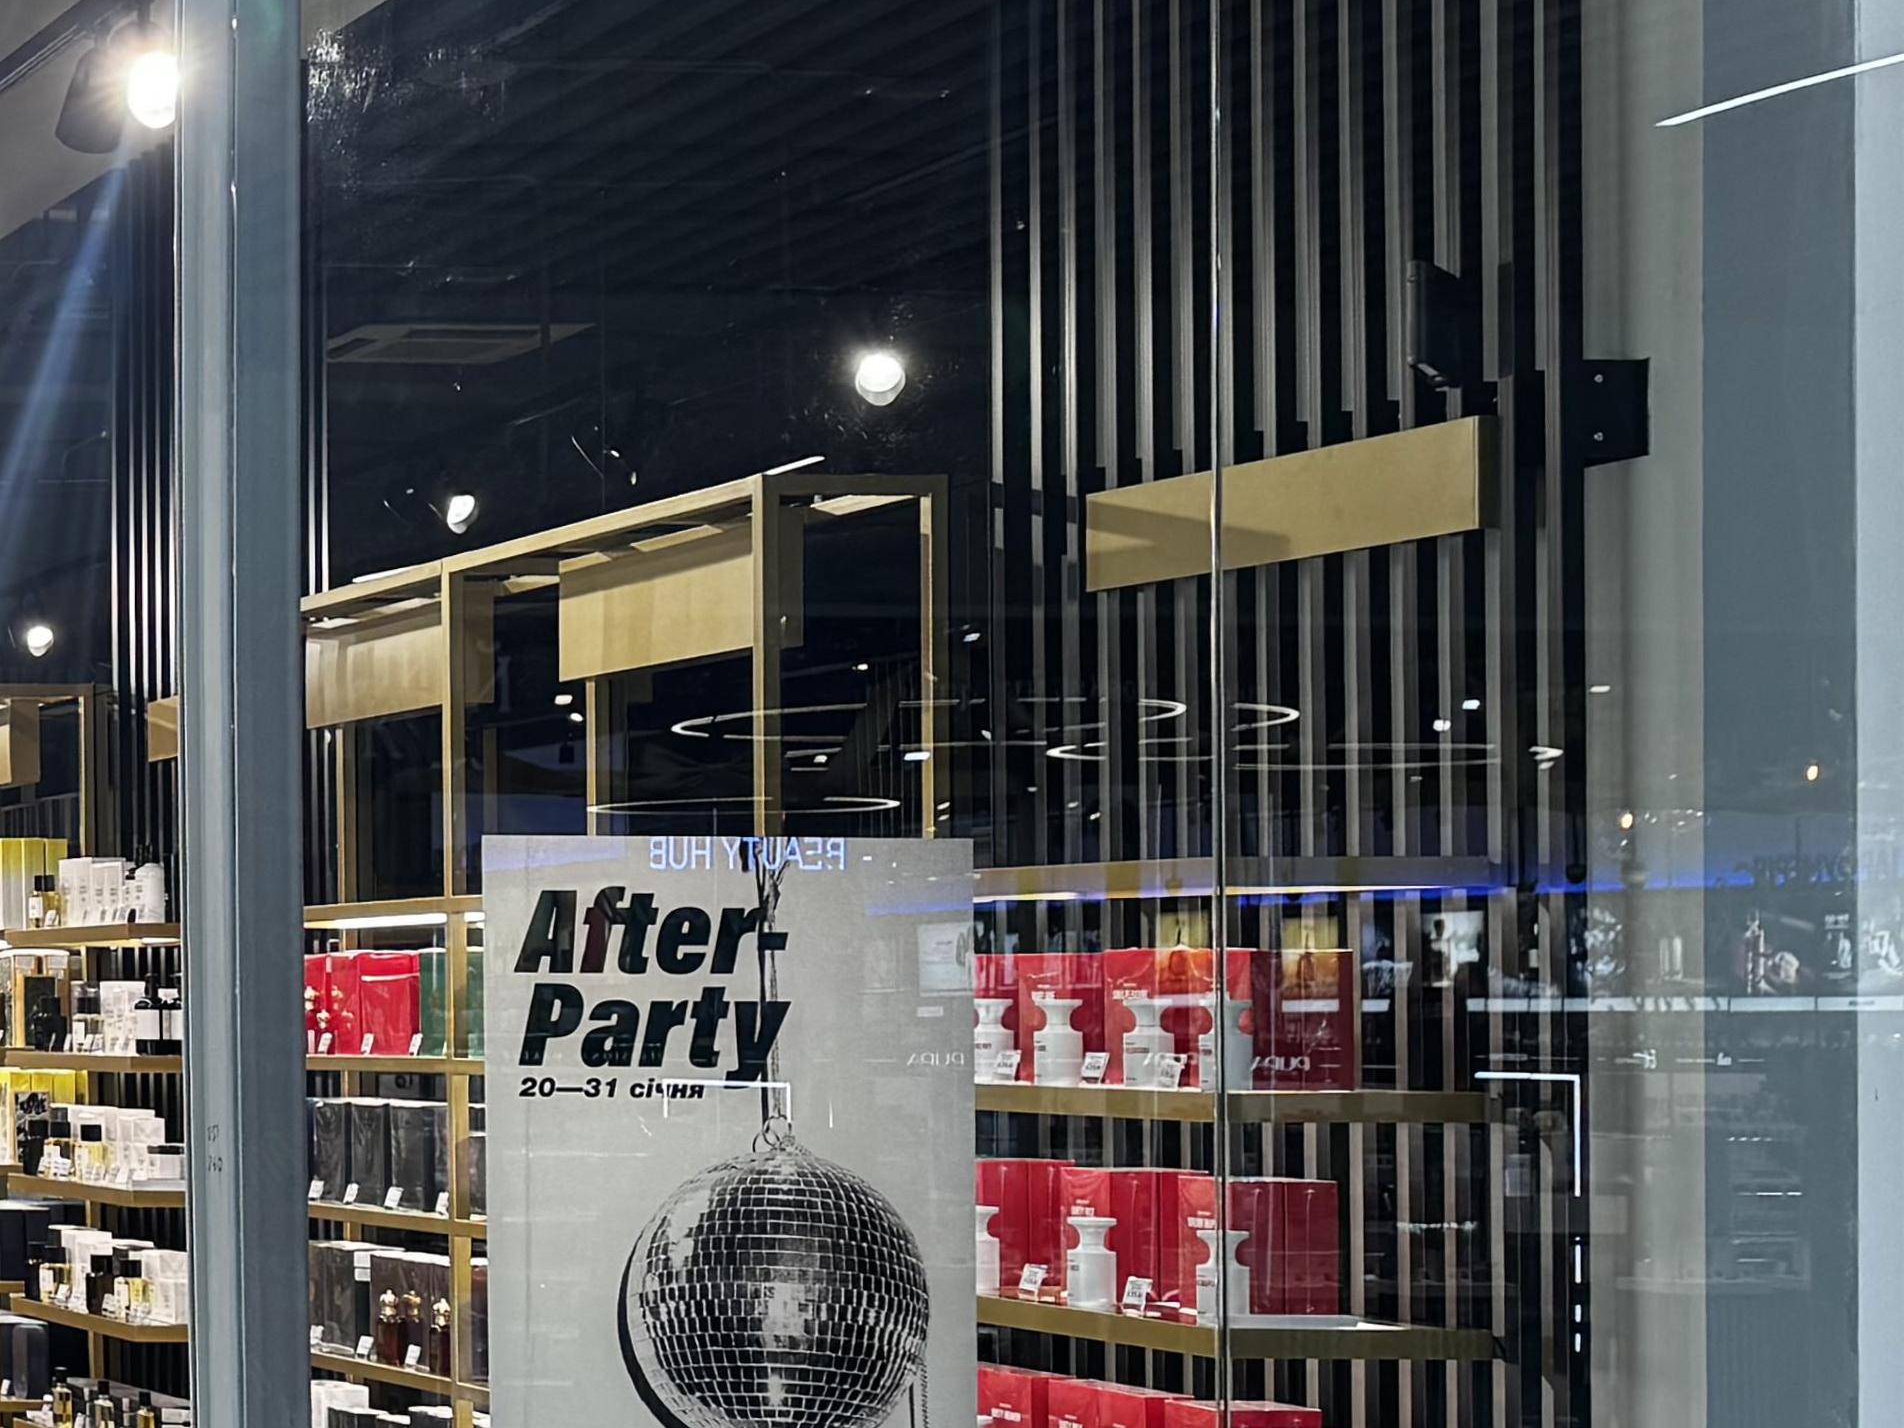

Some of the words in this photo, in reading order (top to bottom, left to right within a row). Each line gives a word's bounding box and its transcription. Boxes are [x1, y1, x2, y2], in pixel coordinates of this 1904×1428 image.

[515, 885, 789, 975] After-
[518, 982, 792, 1090] Party
[629, 1077, 705, 1100] січня
